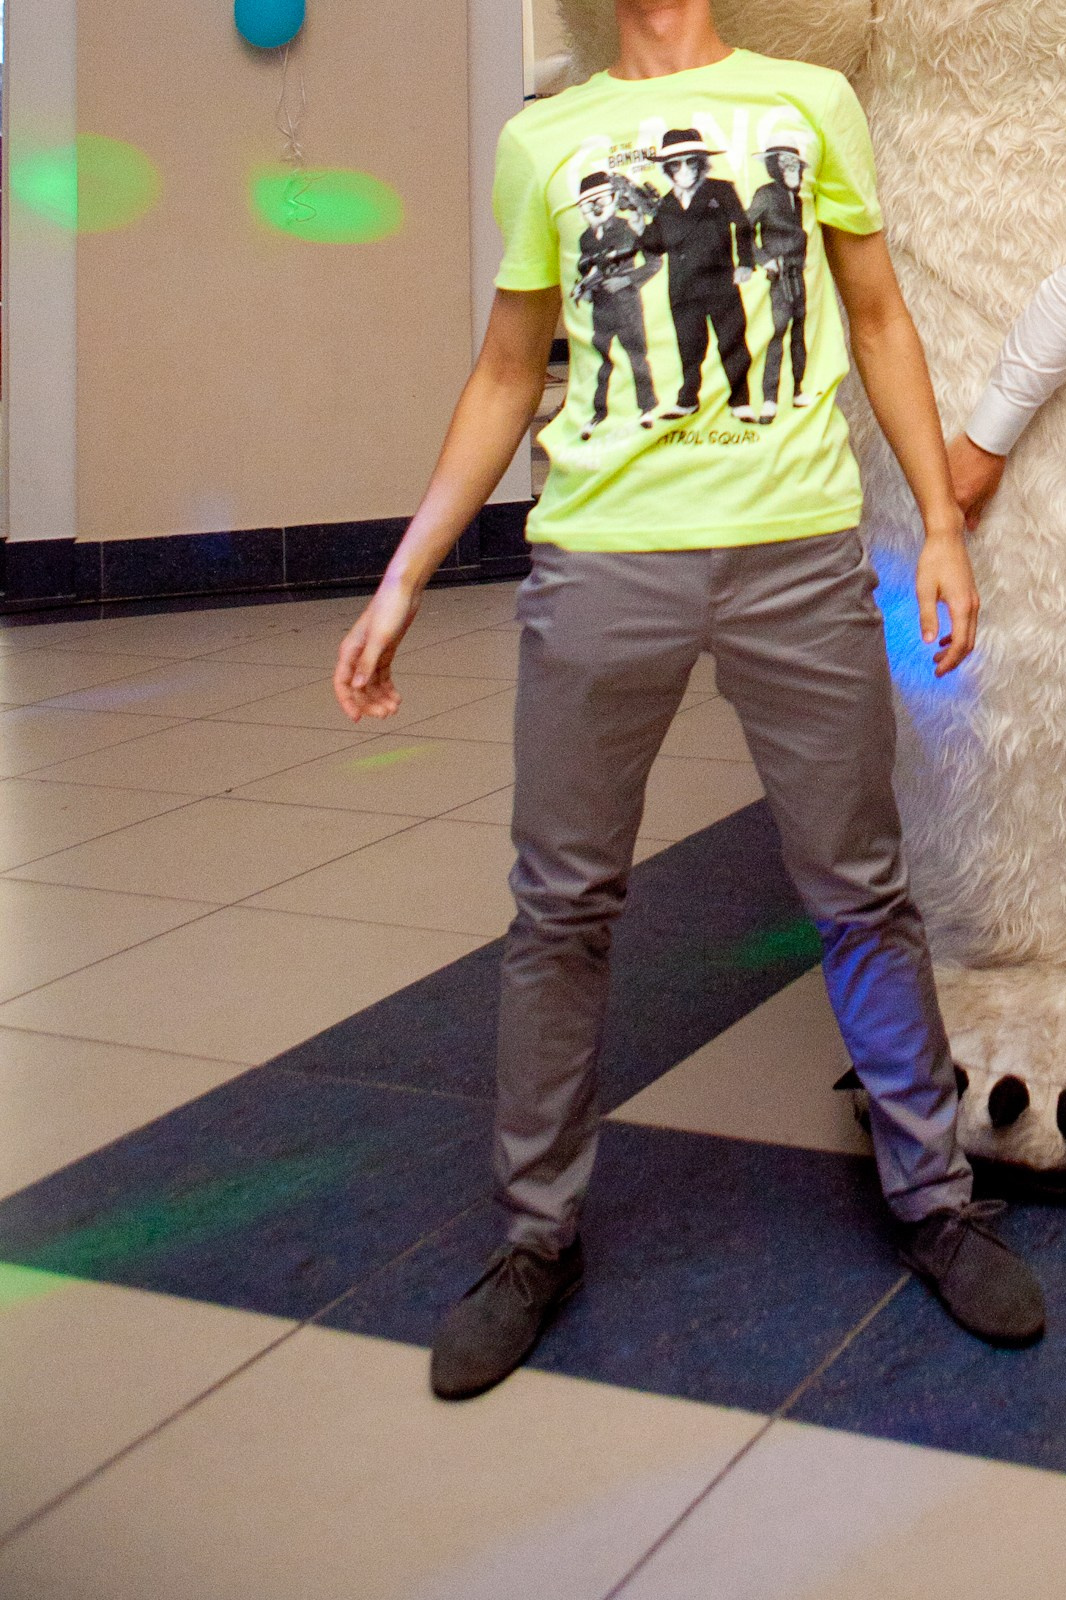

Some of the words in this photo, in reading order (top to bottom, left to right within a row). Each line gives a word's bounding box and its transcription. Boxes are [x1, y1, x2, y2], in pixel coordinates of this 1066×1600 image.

[608, 146, 656, 168] BANANA
[658, 429, 704, 445] ATROL
[708, 429, 760, 445] SQUAD
